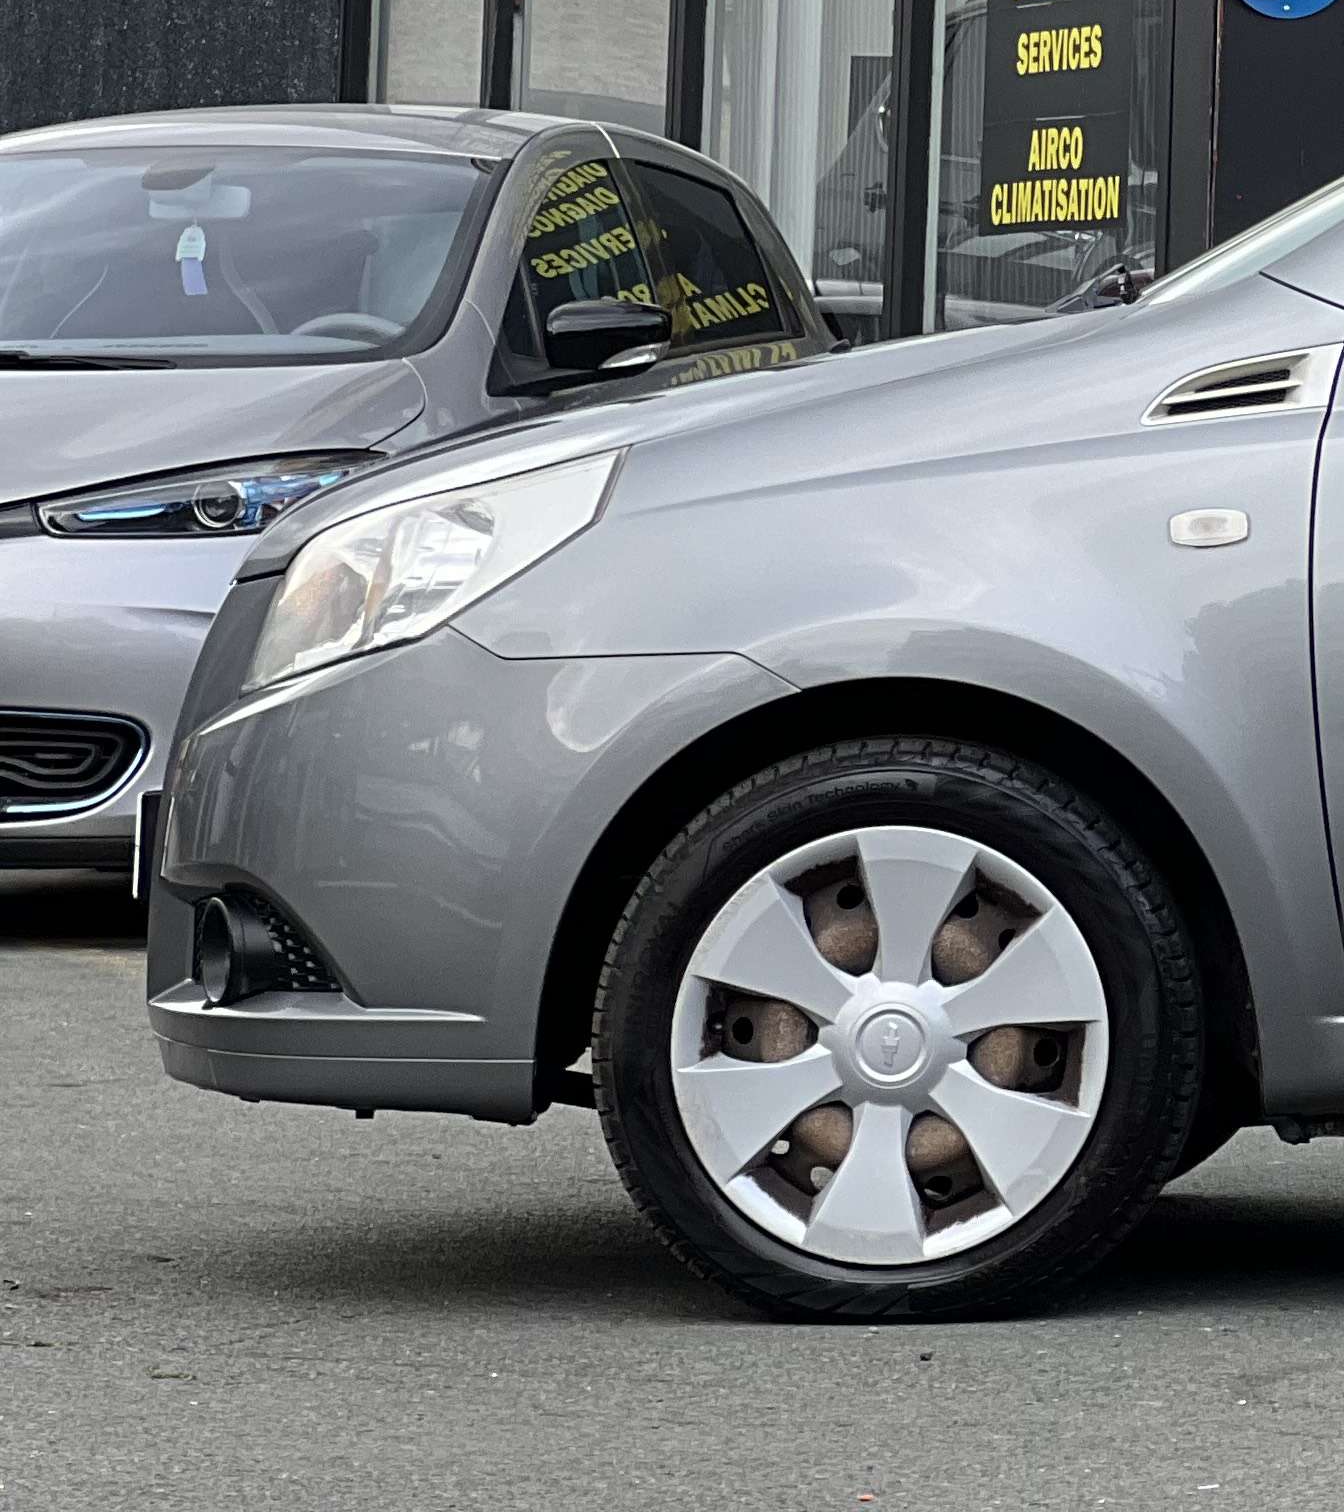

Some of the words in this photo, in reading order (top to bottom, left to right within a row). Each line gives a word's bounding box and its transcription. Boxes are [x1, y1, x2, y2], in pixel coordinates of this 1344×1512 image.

[1016, 24, 1102, 75] SERVICES
[1028, 126, 1083, 171] AIRCO
[991, 176, 1119, 226] CLIMATISATION
